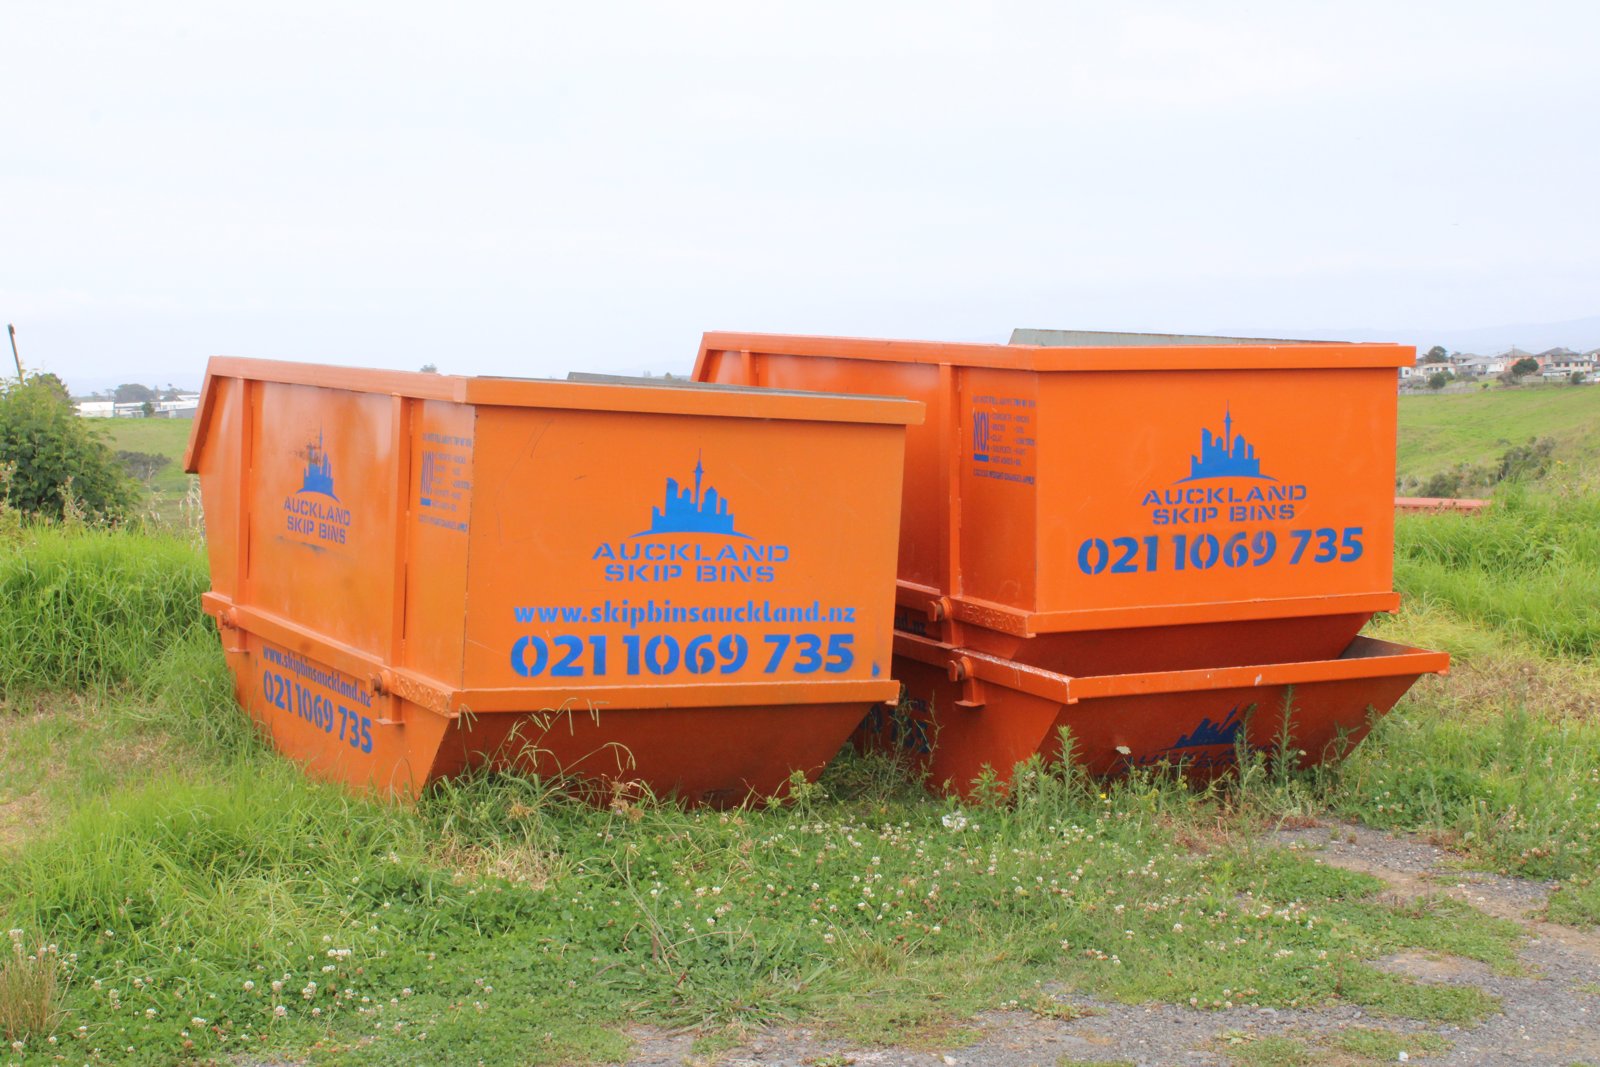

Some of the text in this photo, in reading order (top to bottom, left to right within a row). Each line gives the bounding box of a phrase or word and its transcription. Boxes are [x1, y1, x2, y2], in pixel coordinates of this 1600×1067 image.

[1142, 486, 1306, 506] AUCKLAND
[284, 496, 351, 527] AUCKLAND
[1152, 504, 1295, 524] SKIP BINS
[287, 516, 346, 545] SKIP BINS
[592, 543, 789, 562] AUCKLAND
[1077, 527, 1363, 575] 021 1069 735
[604, 564, 775, 582] SKIP BINS
[514, 600, 855, 629] www.skipbinsauckland.nz
[510, 633, 854, 677] 021 1069 735
[263, 645, 371, 708] www.skipbinsauckland.nz
[264, 670, 372, 754] 021 1069 735
